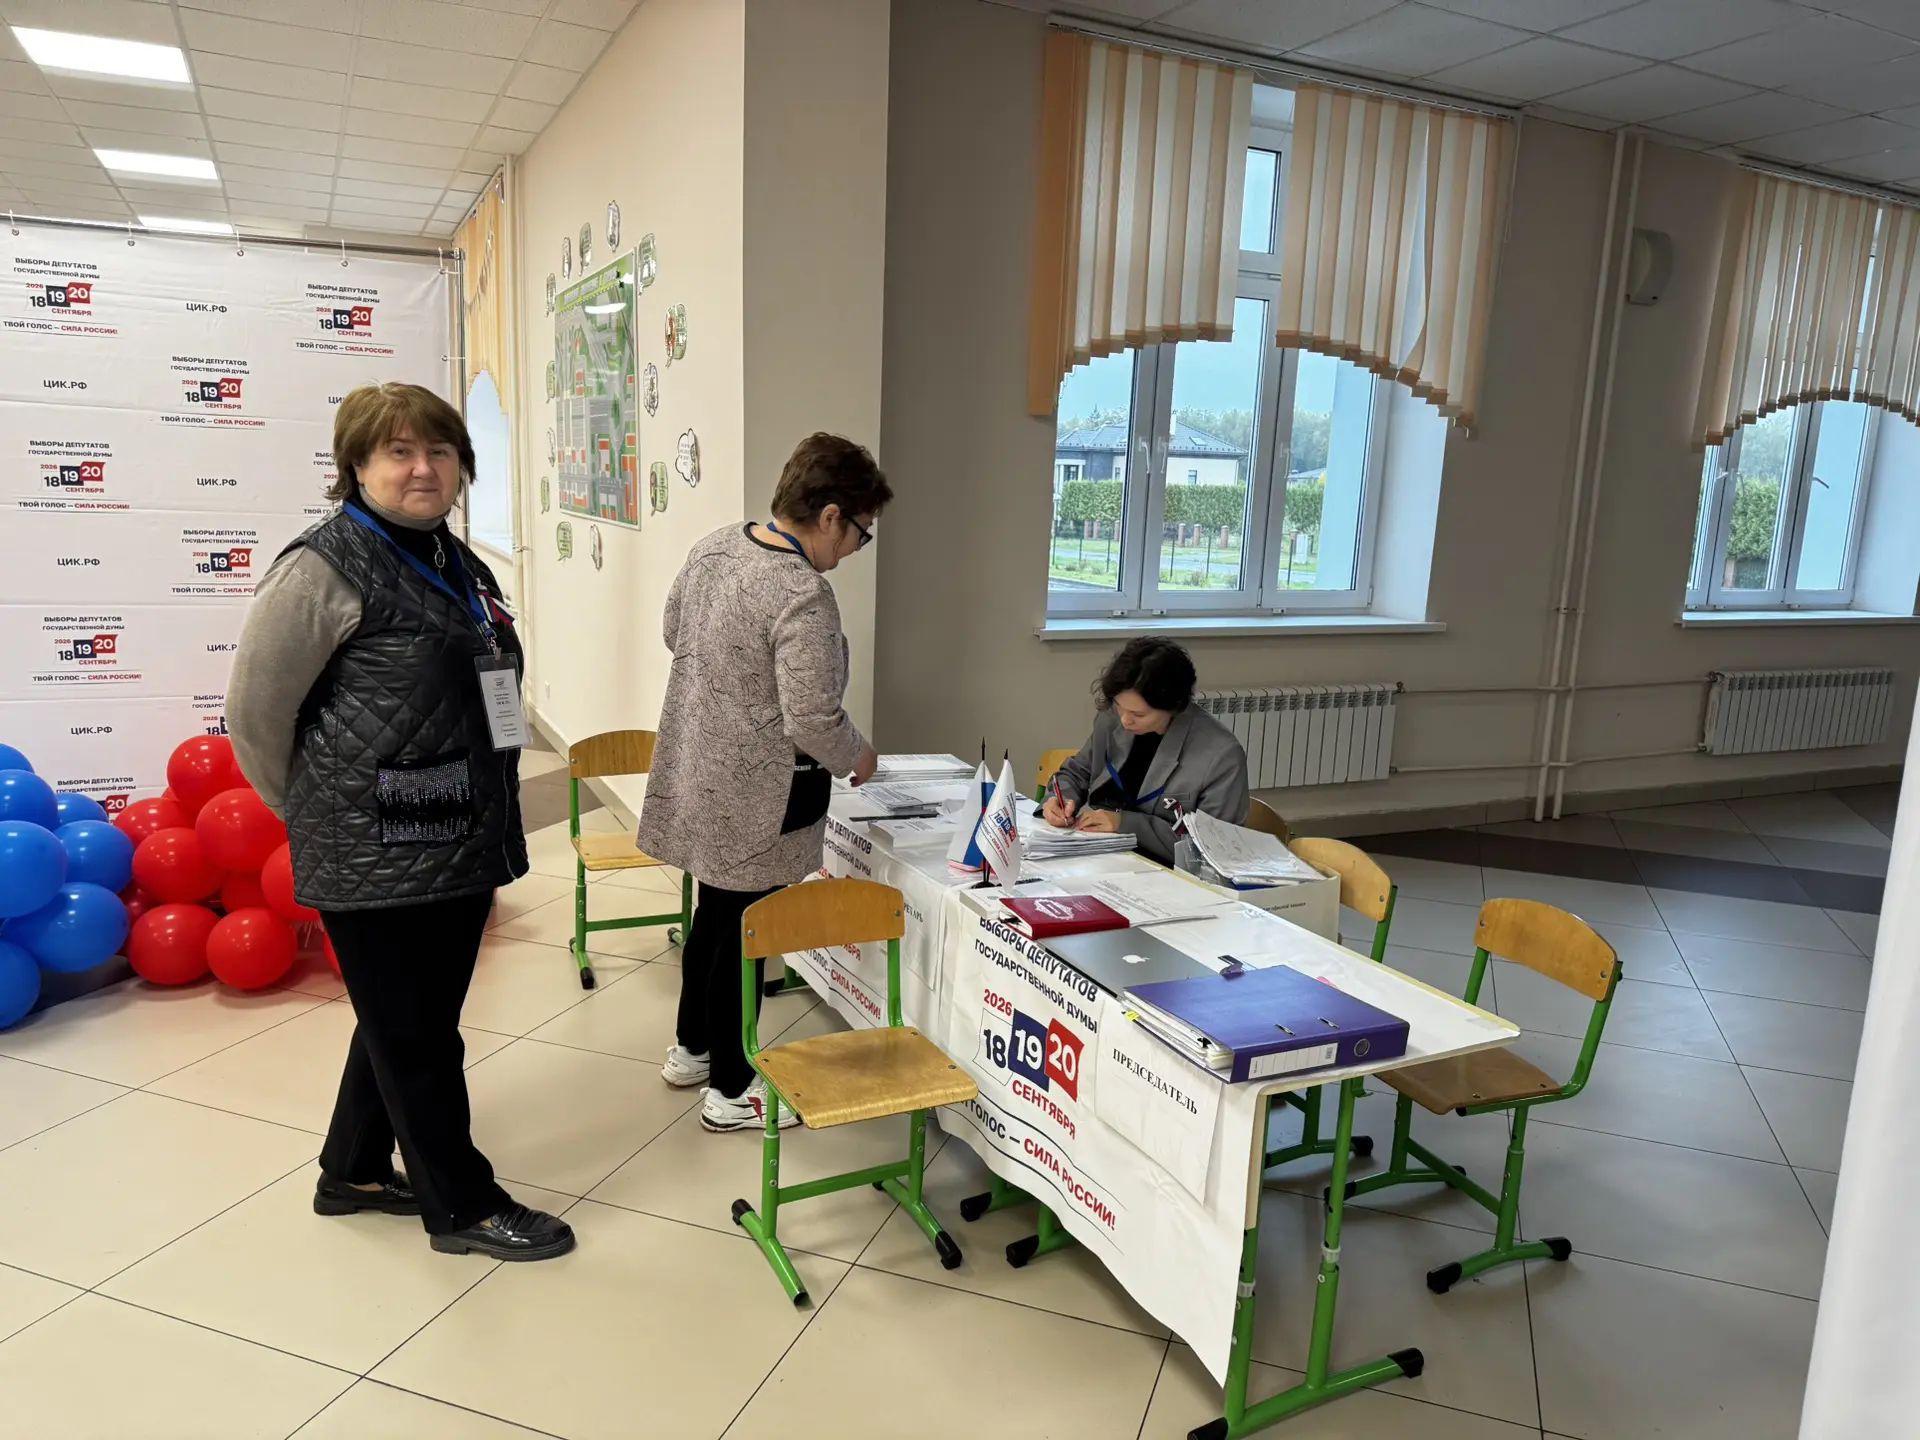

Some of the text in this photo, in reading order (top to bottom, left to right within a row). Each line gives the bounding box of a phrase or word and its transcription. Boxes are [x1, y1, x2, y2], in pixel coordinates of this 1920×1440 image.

[15, 258, 98, 270] ВЫБОРЫ ДЕПУТАТОВ
[14, 267, 79, 278] ГОСУДАРСТВЕННОЙ
[308, 284, 378, 295] ВЫБОРЫ ДЕПУТАТОВ
[30, 288, 88, 307] 18 19 20
[306, 293, 361, 302] ГОСУДАРСТВЕННОЙ
[52, 308, 92, 316] СЕНТЯБРЯ
[186, 303, 227, 313] ЦИК.РФ
[319, 310, 369, 330] 18 19 20
[338, 330, 372, 338] СЕНТЯБРЯ
[345, 345, 363, 353] СИЛА
[365, 347, 394, 355] РОССИИ!
[172, 356, 247, 366] ВЫБОРЫ ДЕПУТАТОВ
[170, 365, 230, 374] ГОСУДАРСТВЕННОЙ
[43, 380, 87, 390] ЦИК.РФ
[185, 382, 238, 403] 18 19 20
[182, 417, 206, 425] ГОЛОС
[214, 418, 233, 426] СИЛА
[65, 441, 110, 449] ДЕПУТАТОВ
[28, 449, 92, 458] ГОСУДАРСТВЕННОЙ
[44, 466, 100, 487] 18 19 20
[197, 478, 237, 487] ЦИК.РФ
[57, 558, 100, 567] ЦИК.РФ
[196, 553, 247, 574] 18 19 20
[58, 639, 113, 661] 18 19 20
[207, 644, 237, 652] ЦИК.Р
[71, 726, 113, 735] ЦИК.РФ
[206, 727, 220, 735] 18
[107, 799, 125, 809] 20
[835, 821, 872, 855] ДЕПУТАТОВ
[904, 903, 923, 923] РЕТАРЬ
[980, 917, 1098, 1003] ВЫБОРЫ ДЕПУТАТОВ
[975, 939, 1098, 1034] ГОСУДАРСТВЕННОЙ ДУМЫ
[831, 969, 850, 993] СИЛА
[851, 985, 881, 1019] РОССИИ!
[984, 989, 1012, 1017] 2026
[983, 1028, 1076, 1080] 18 19 20
[1113, 1048, 1198, 1116] ПРЕДСЕДАТЕЛЬ
[1012, 1080, 1076, 1140] СЕНТЯБРЯ
[971, 1100, 1006, 1139] ГОЛОС
[1024, 1138, 1060, 1177] СИЛА
[1062, 1175, 1116, 1231] РОССИИ!
